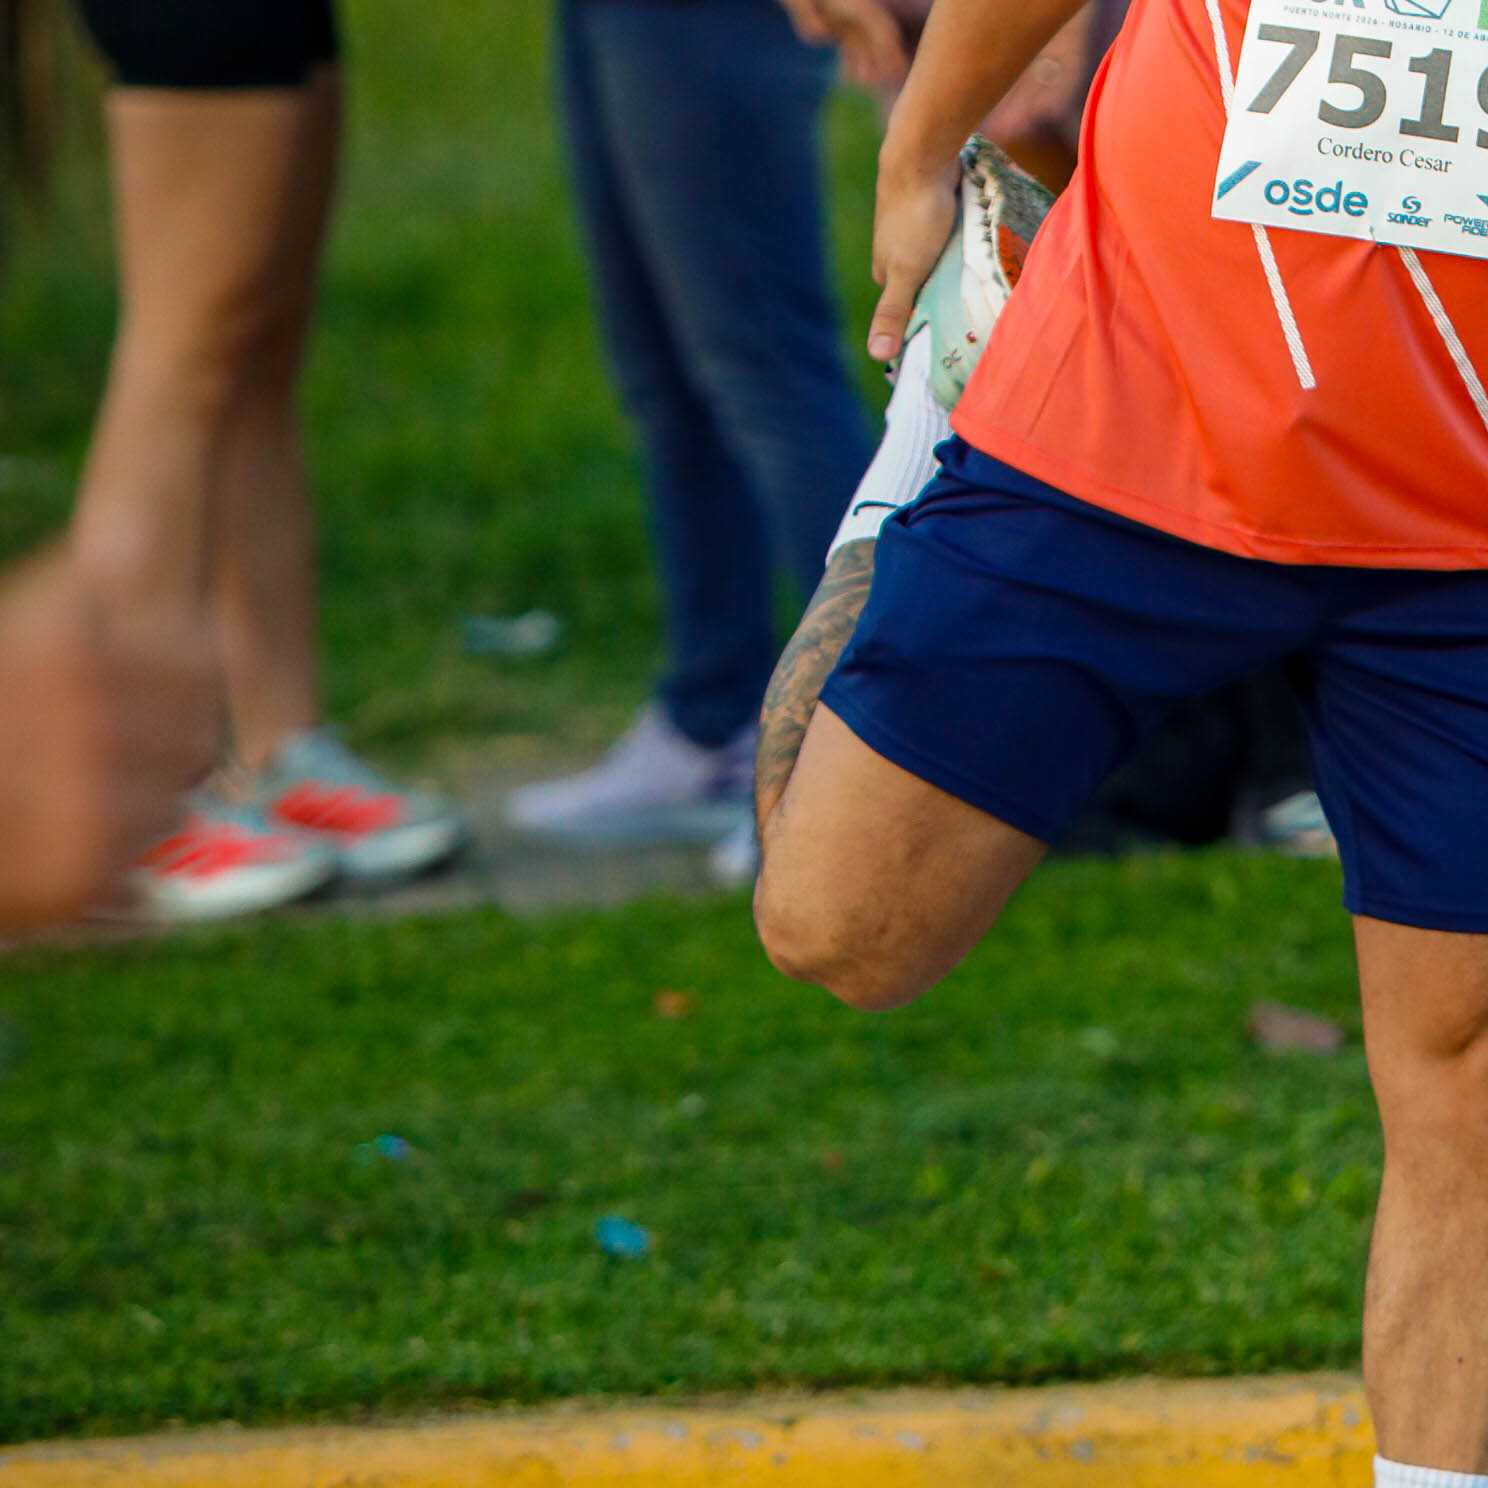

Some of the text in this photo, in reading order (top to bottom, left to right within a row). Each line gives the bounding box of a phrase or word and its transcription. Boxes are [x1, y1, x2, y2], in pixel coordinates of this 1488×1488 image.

[1283, 4, 1319, 17] PUERTO
[1322, 10, 1352, 21] NORTE
[1388, 19, 1432, 33] ROSARIO
[1443, 28, 1454, 37] 12
[1457, 30, 1470, 40] DE
[1317, 136, 1453, 174] Cordero Cesar
[1264, 178, 1369, 217] osde
